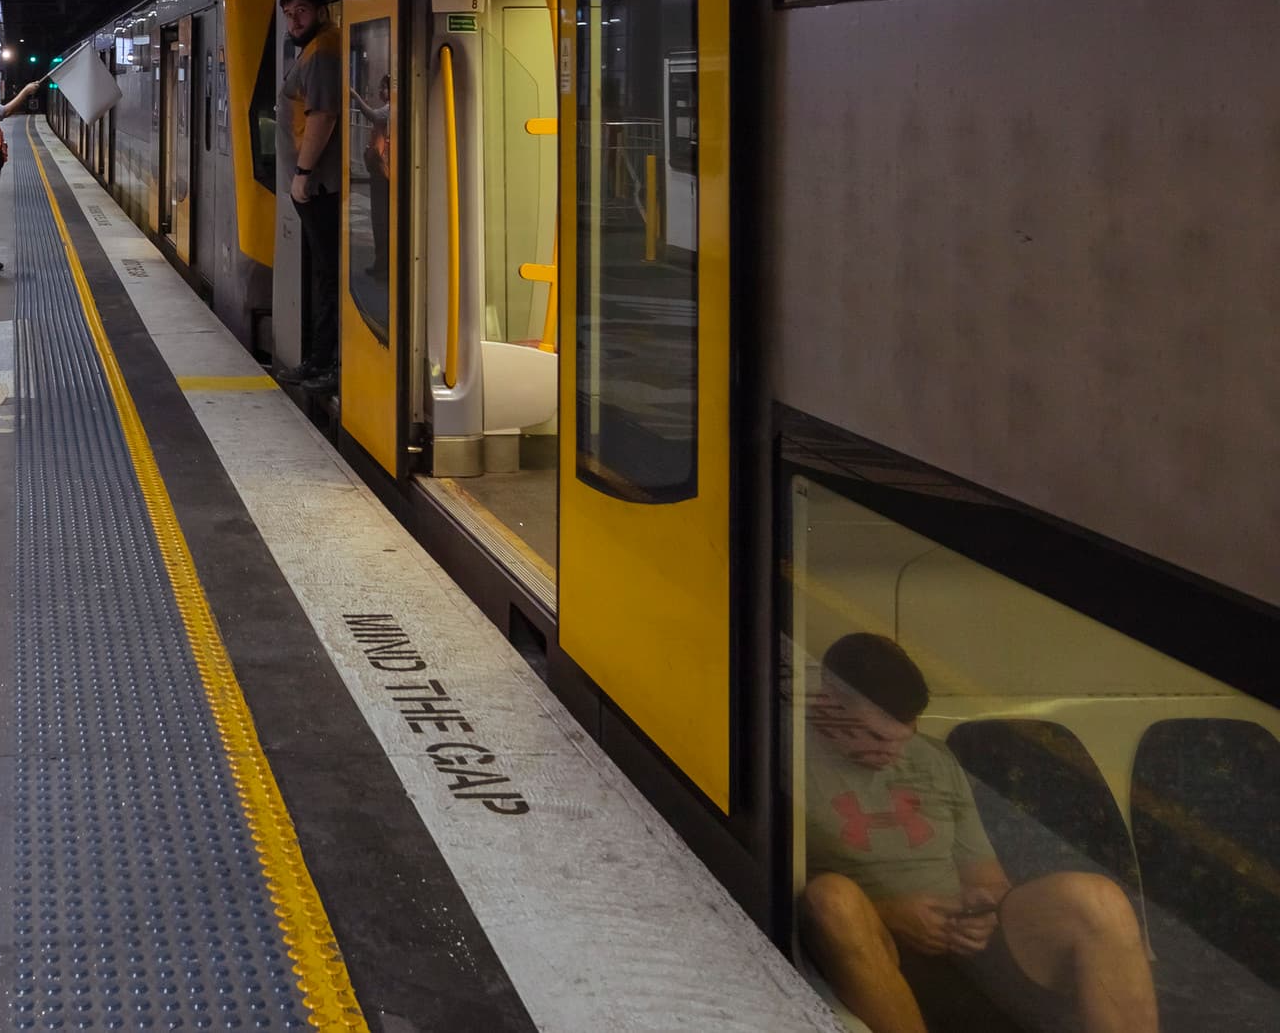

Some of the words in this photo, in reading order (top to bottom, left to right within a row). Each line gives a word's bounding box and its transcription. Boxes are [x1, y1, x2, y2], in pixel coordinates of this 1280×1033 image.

[342, 614, 427, 672] MIND
[384, 679, 475, 733] THE
[425, 742, 531, 815] GAP
